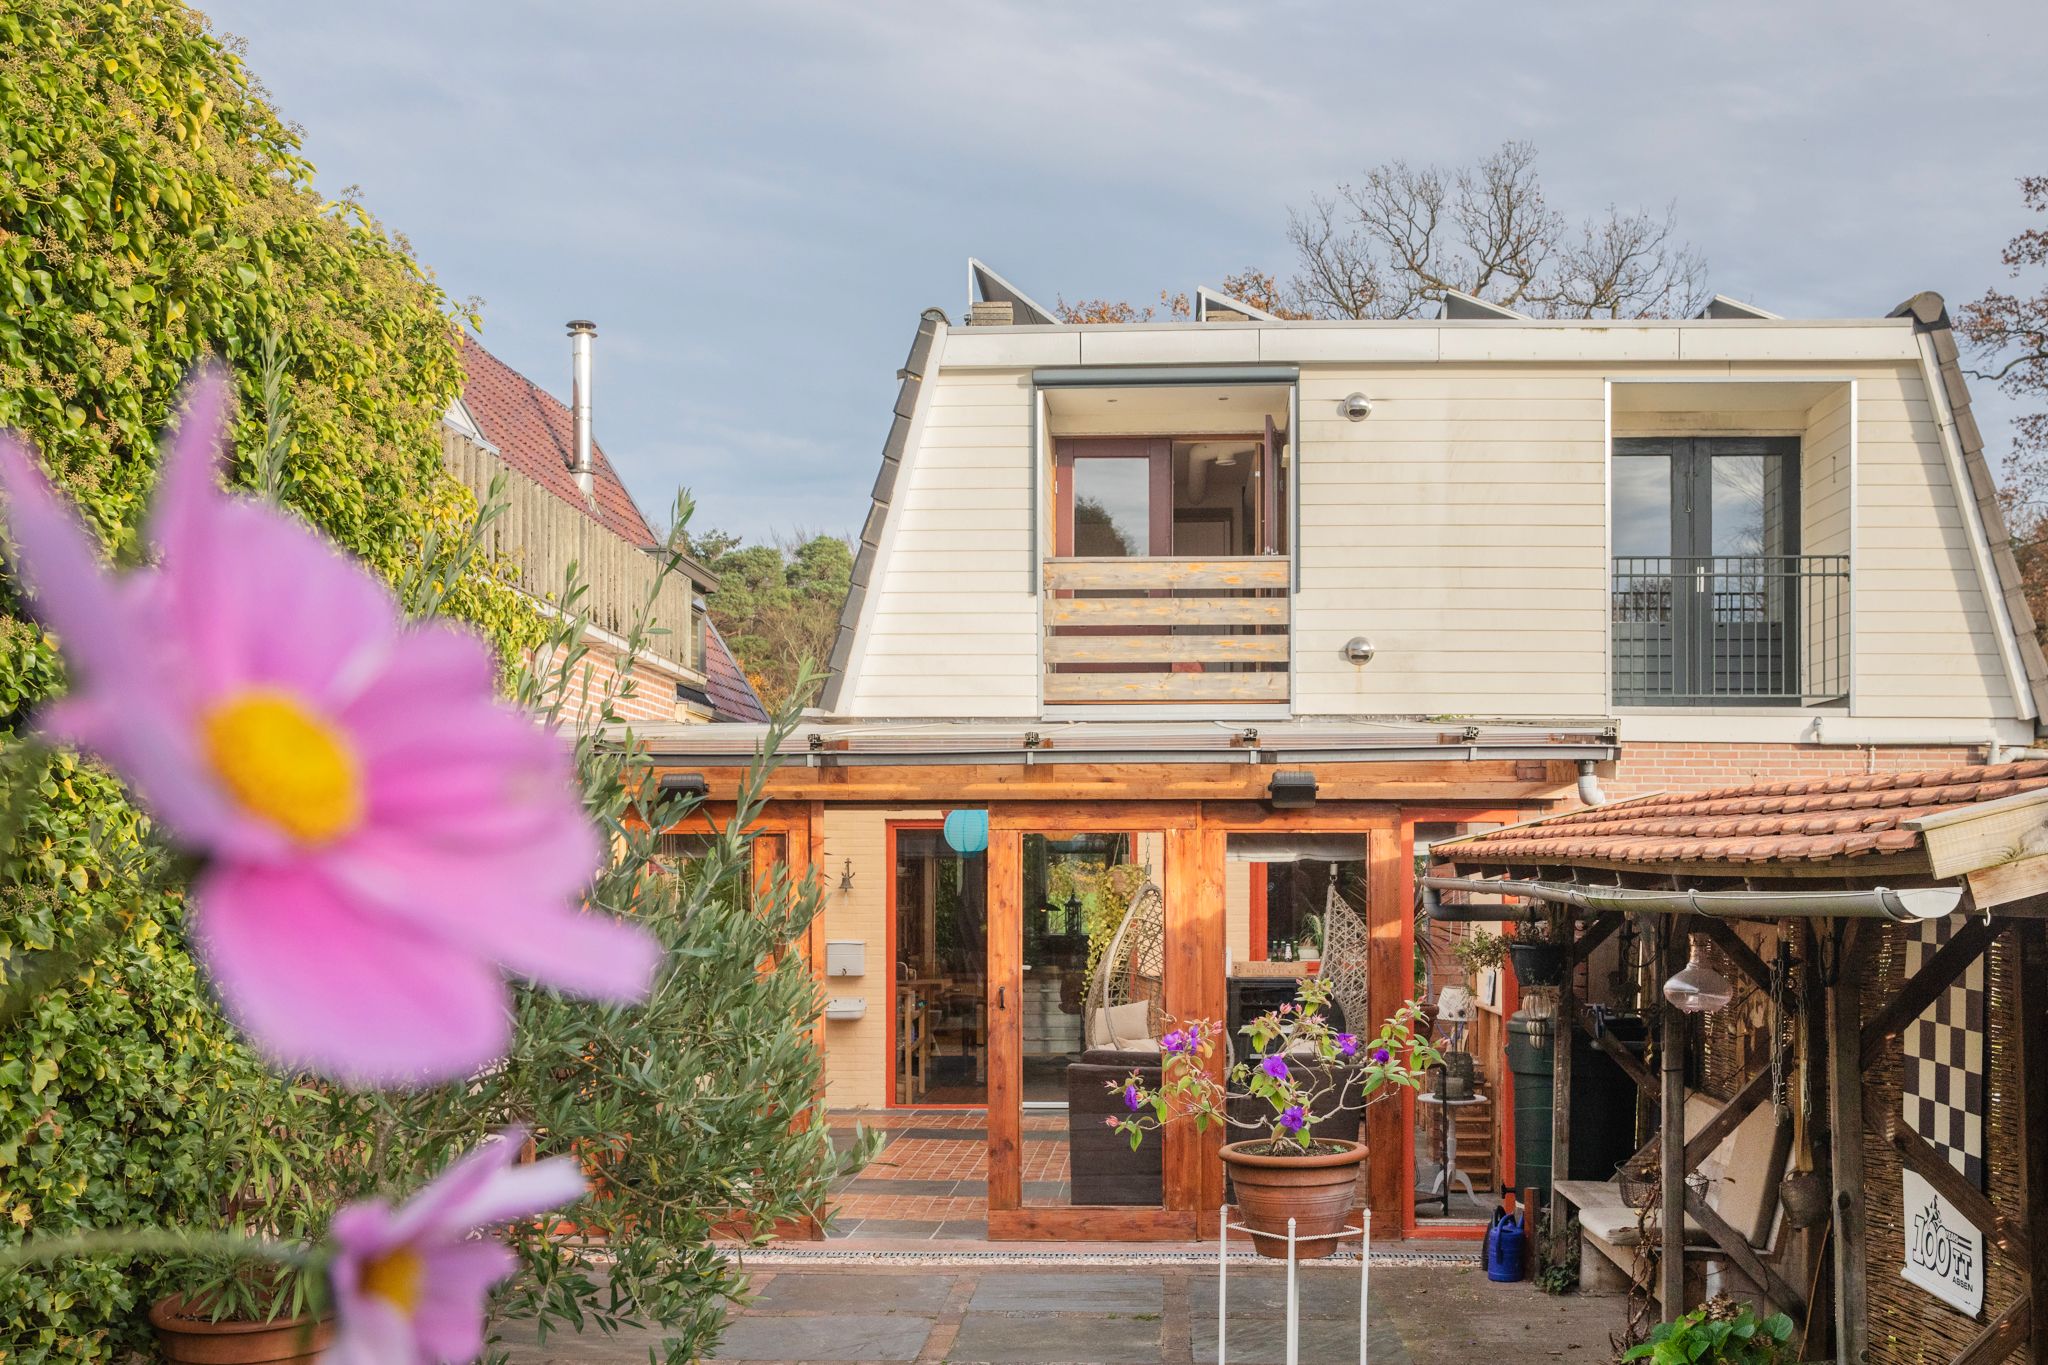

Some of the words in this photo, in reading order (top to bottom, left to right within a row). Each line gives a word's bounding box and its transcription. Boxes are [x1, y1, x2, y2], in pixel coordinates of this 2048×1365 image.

[1913, 1214, 1951, 1277] 100
[1952, 1247, 1972, 1280] TT
[1952, 1276, 1973, 1292] ASSEN
